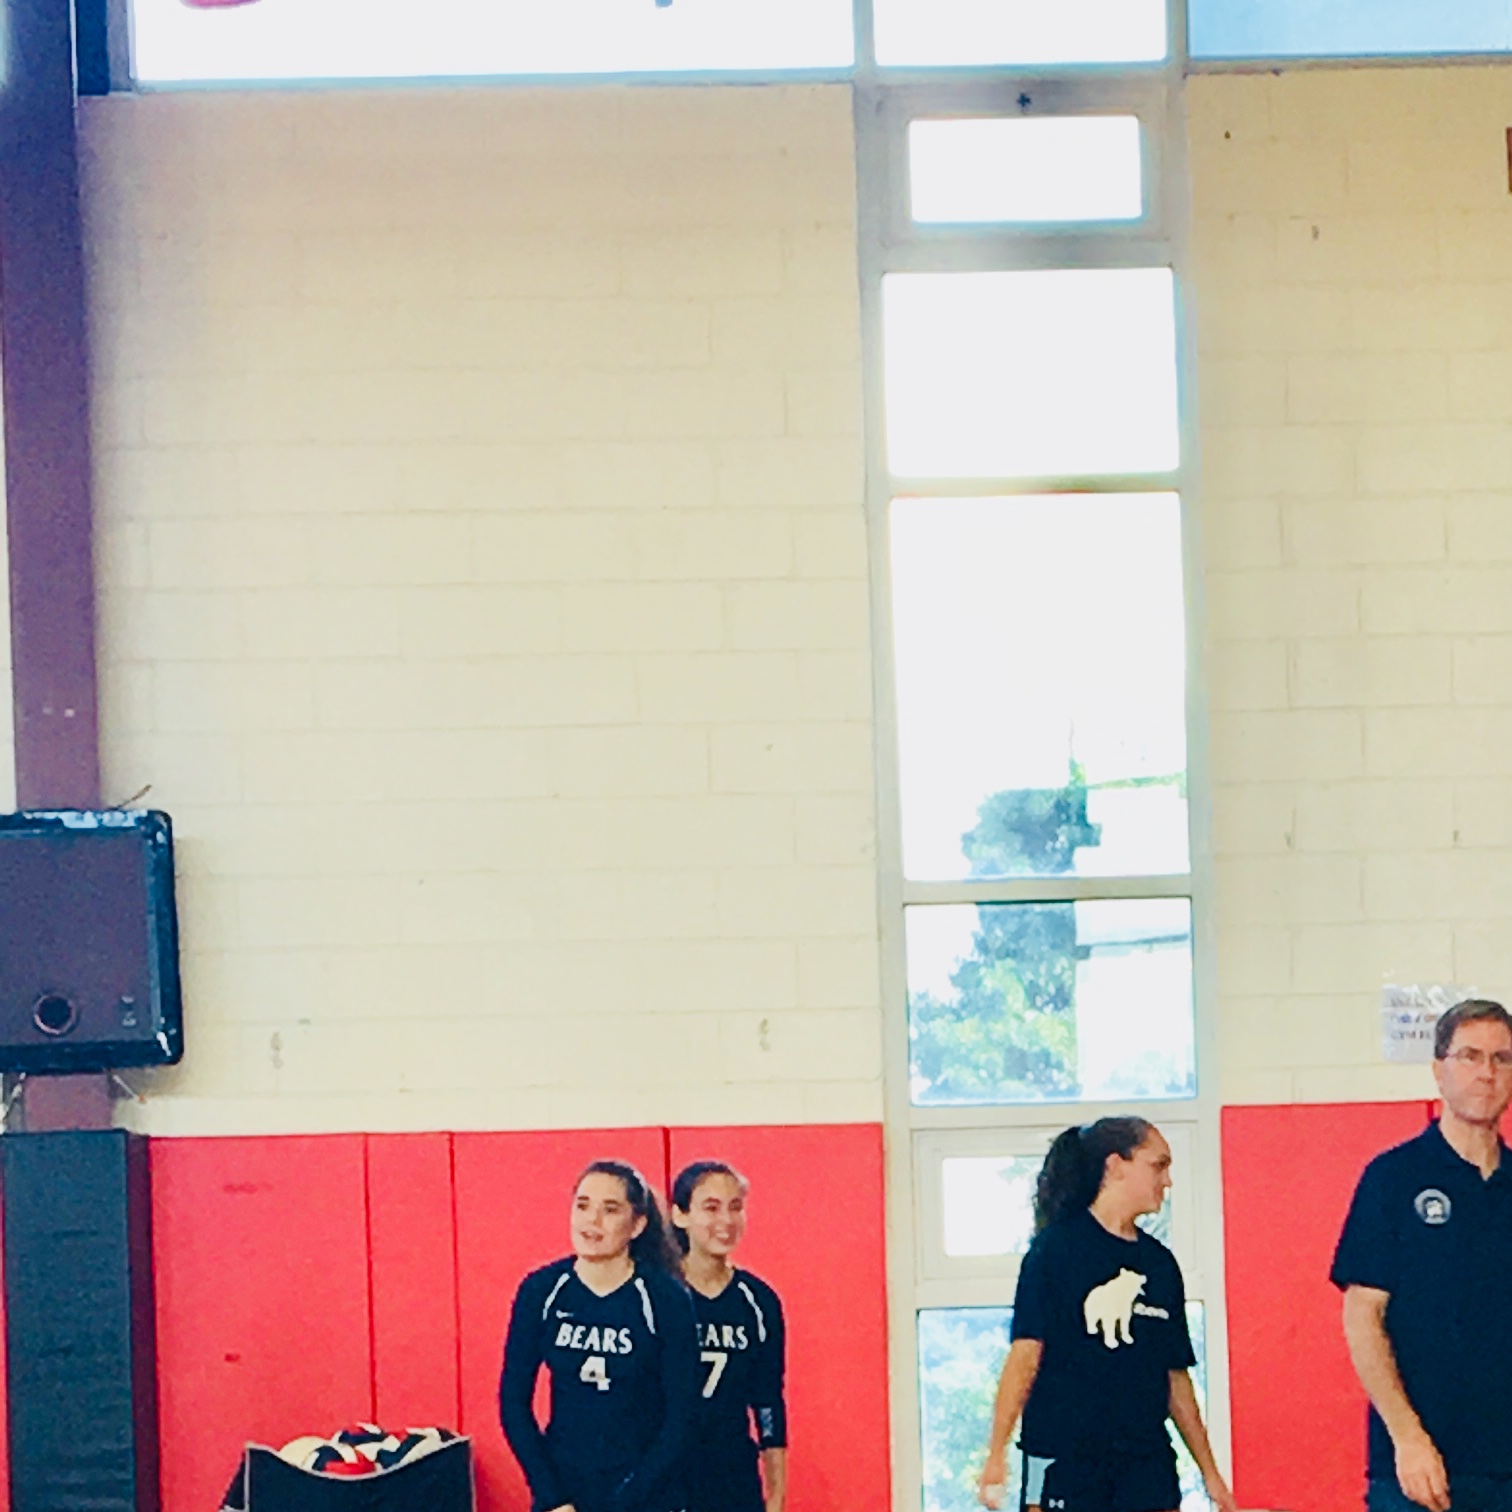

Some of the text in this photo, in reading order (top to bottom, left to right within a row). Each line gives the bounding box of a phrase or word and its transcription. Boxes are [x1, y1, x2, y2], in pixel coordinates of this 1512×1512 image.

[555, 1323, 633, 1354] BEARS
[580, 1355, 612, 1391] 4
[700, 1351, 728, 1398] 7
